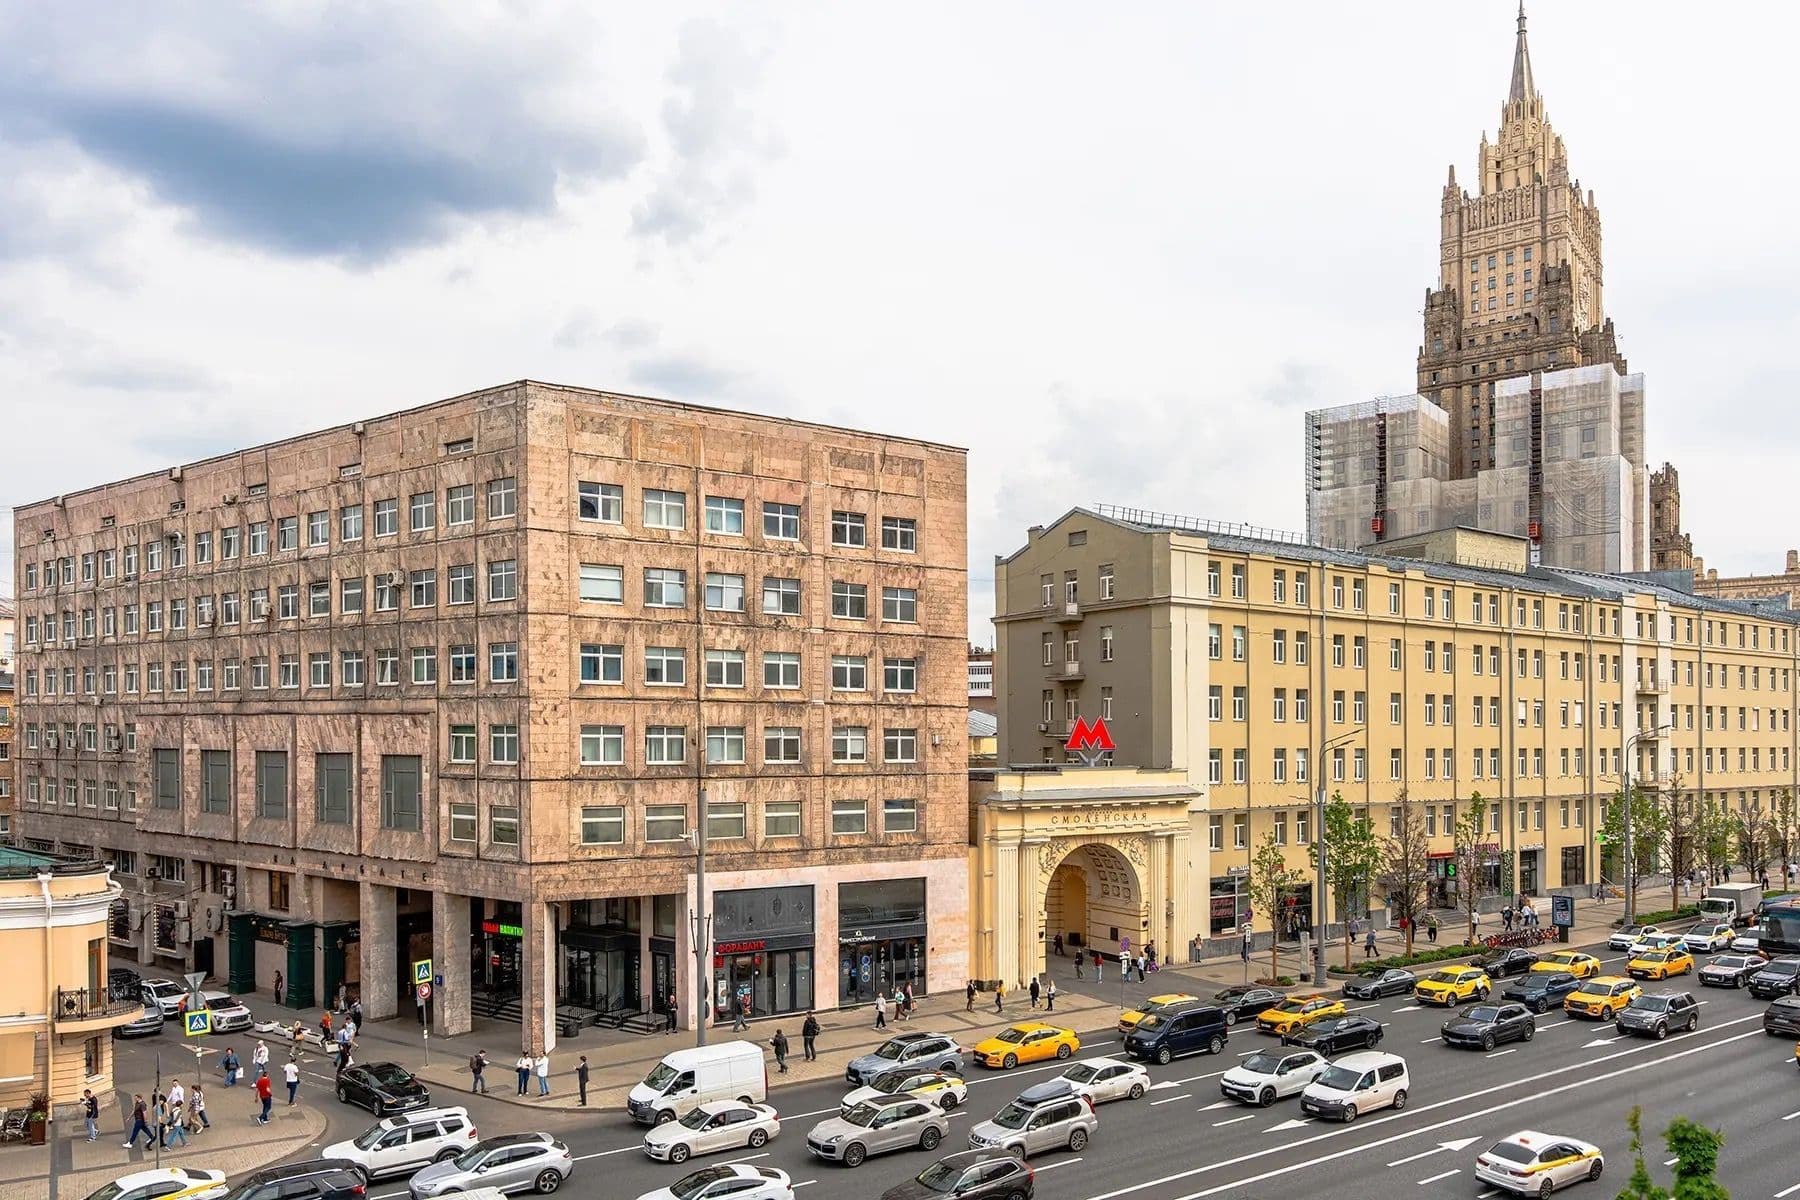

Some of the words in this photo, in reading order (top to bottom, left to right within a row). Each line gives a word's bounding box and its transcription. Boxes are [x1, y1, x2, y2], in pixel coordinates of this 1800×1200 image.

[1051, 812, 1147, 824] СМОЛЕНСКАЯ
[322, 861, 428, 882] АРБАТЕ
[1448, 864, 1456, 876] $
[718, 940, 767, 953] ФОРАБАНК
